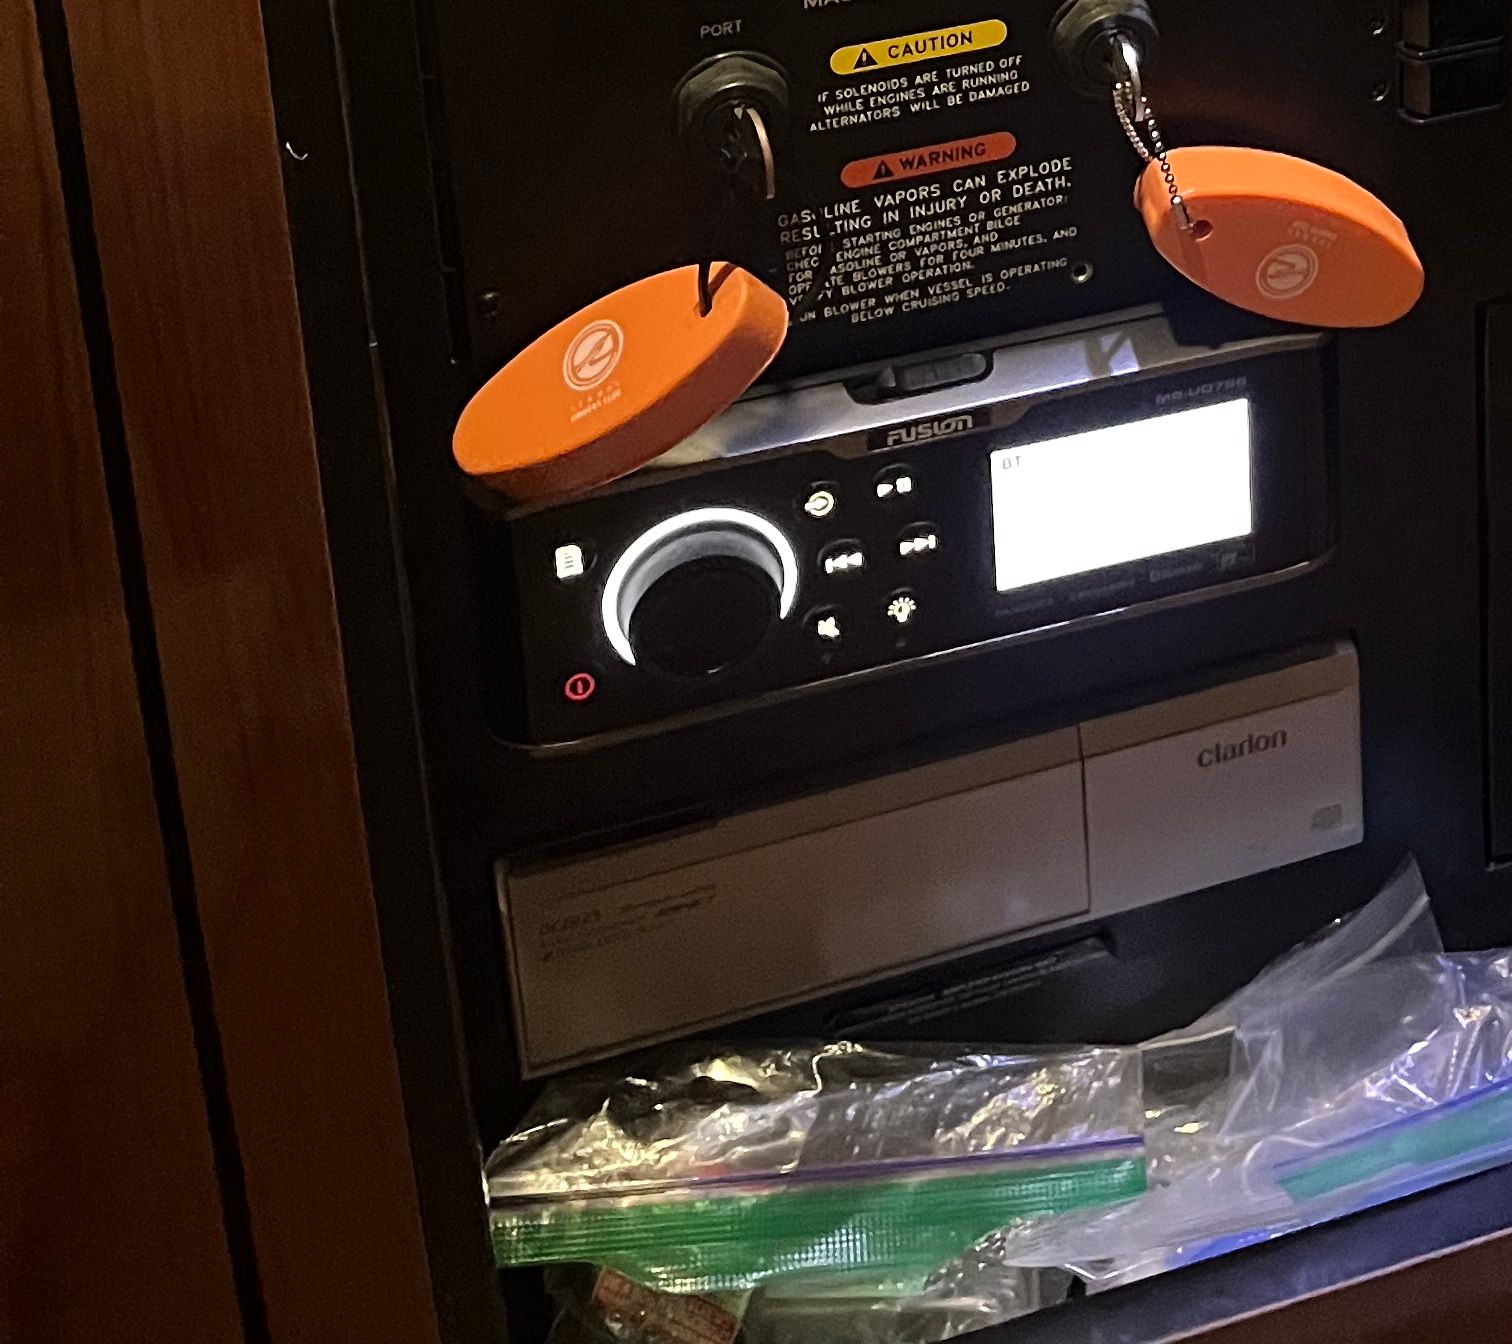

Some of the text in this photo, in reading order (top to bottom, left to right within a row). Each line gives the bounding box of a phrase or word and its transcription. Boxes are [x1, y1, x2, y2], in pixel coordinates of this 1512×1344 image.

[701, 20, 741, 37] PORT
[888, 30, 973, 59] CAUTION
[818, 55, 1022, 104] IF SOLENOIDS ARE TURNED OFF
[824, 70, 1019, 115] WHILE ENGINES ARE RUNNING
[810, 78, 1029, 131] ALTERNATORS WILL BE DAMAGED
[899, 141, 987, 172] WARNING
[874, 184, 944, 211] VAPORS
[953, 175, 985, 192] CAN
[998, 157, 1071, 187] EXPLODE
[1197, 728, 1289, 769] clarion
